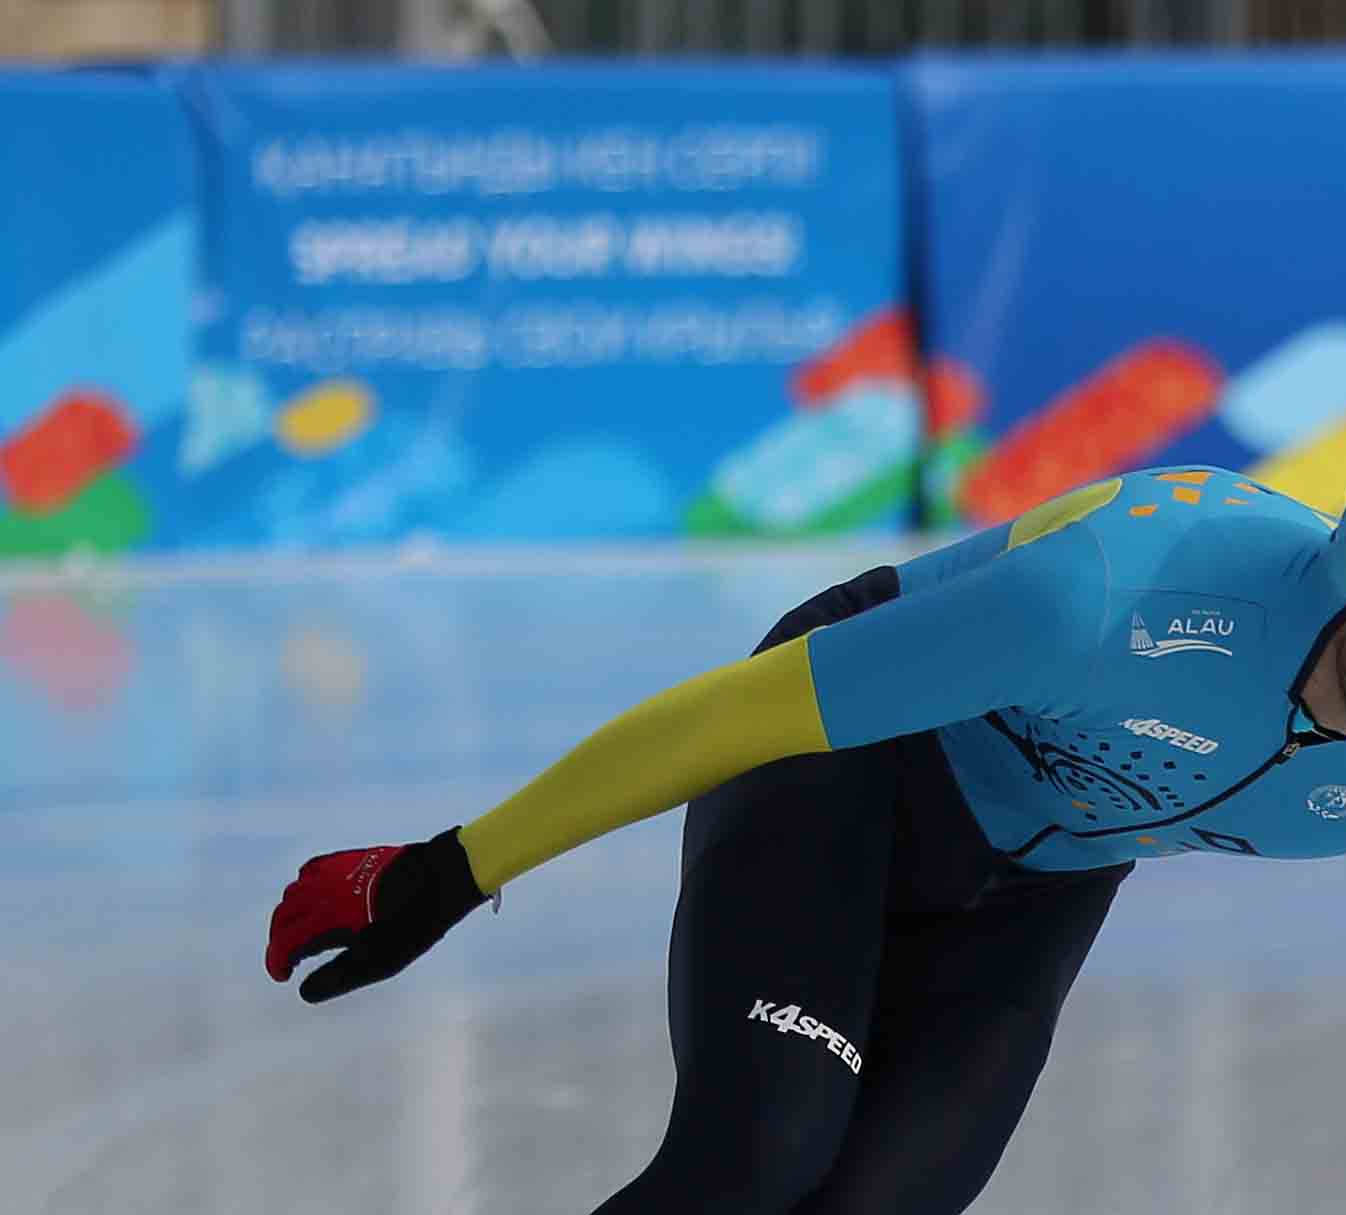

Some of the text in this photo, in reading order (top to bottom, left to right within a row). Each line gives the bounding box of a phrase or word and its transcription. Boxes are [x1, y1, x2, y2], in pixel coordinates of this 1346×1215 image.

[1168, 618, 1234, 636] ALAU
[1118, 719, 1219, 754] K4SPEED
[747, 999, 862, 1075] K4SPEED
